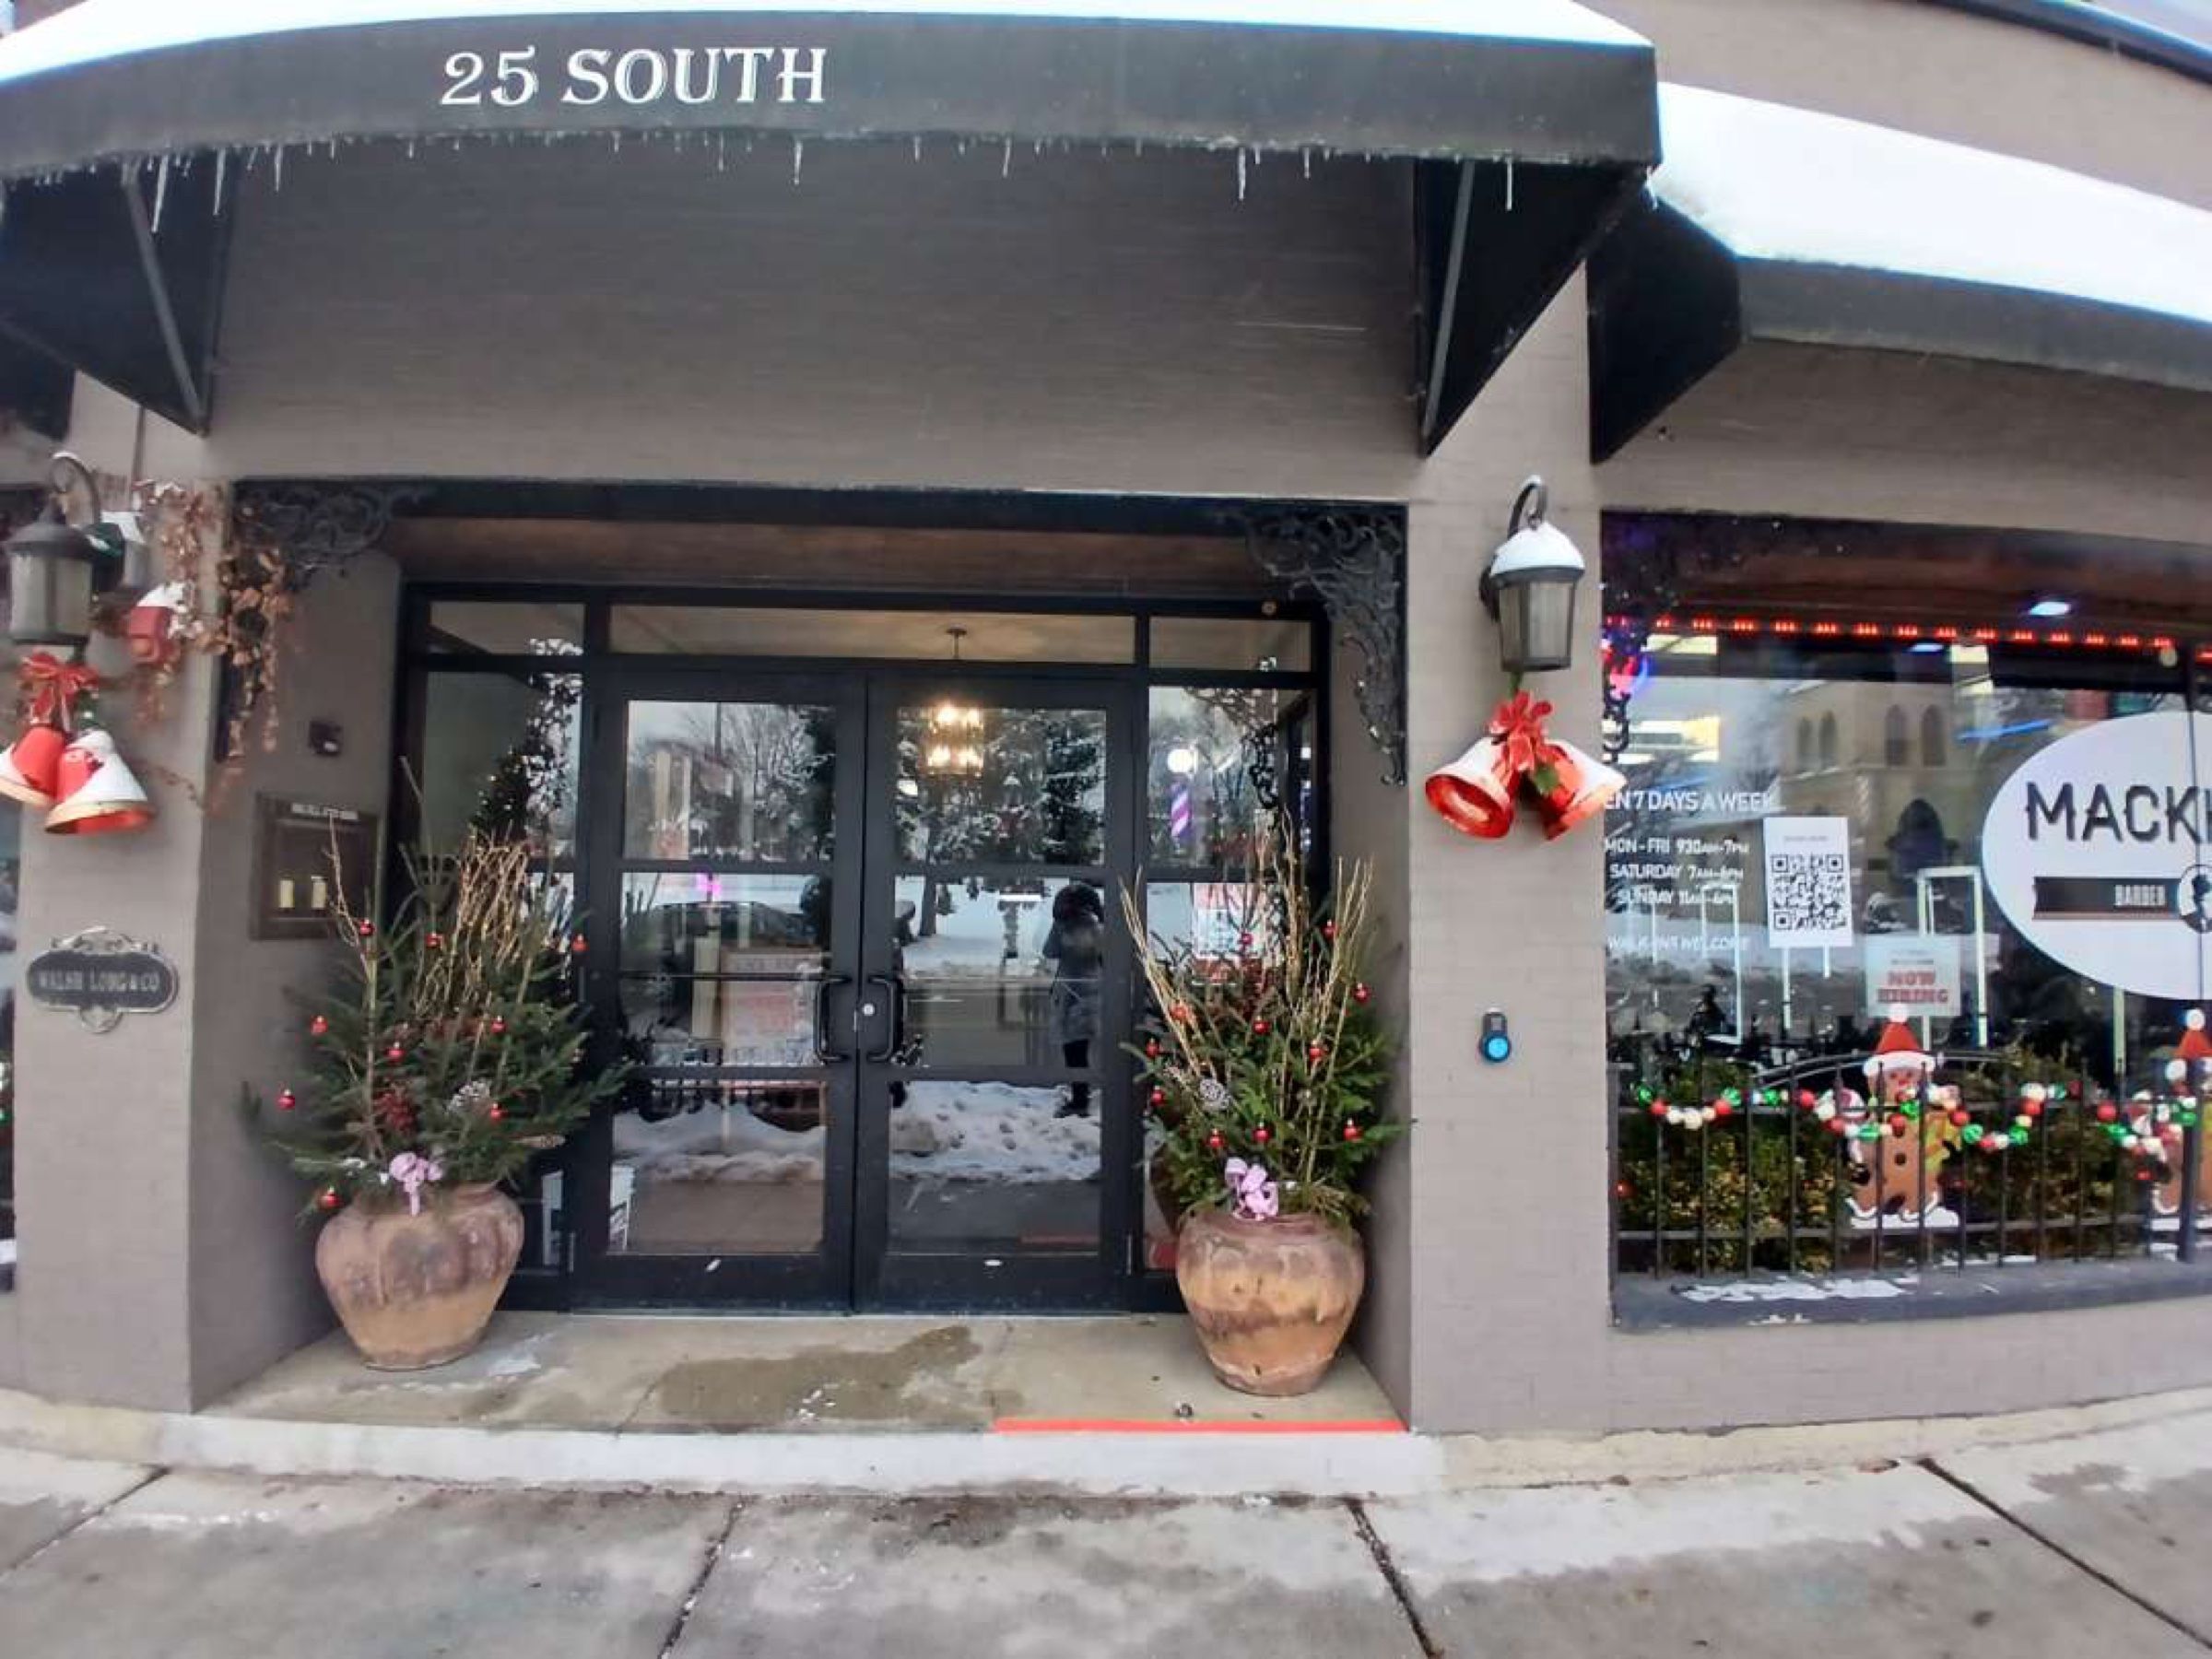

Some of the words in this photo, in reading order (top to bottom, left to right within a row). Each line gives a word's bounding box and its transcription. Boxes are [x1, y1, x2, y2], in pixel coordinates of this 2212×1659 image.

[440, 44, 539, 107] 25
[560, 48, 827, 105] SOUTH
[1633, 790, 1643, 810] 7
[1648, 790, 1699, 811] DAYS
[1701, 792, 1717, 811] A
[1719, 792, 1772, 812] WEEK
[1609, 864, 1681, 879] SATURDAY
[1888, 970, 1936, 985] NOW
[1877, 988, 1948, 1003] HIRING
